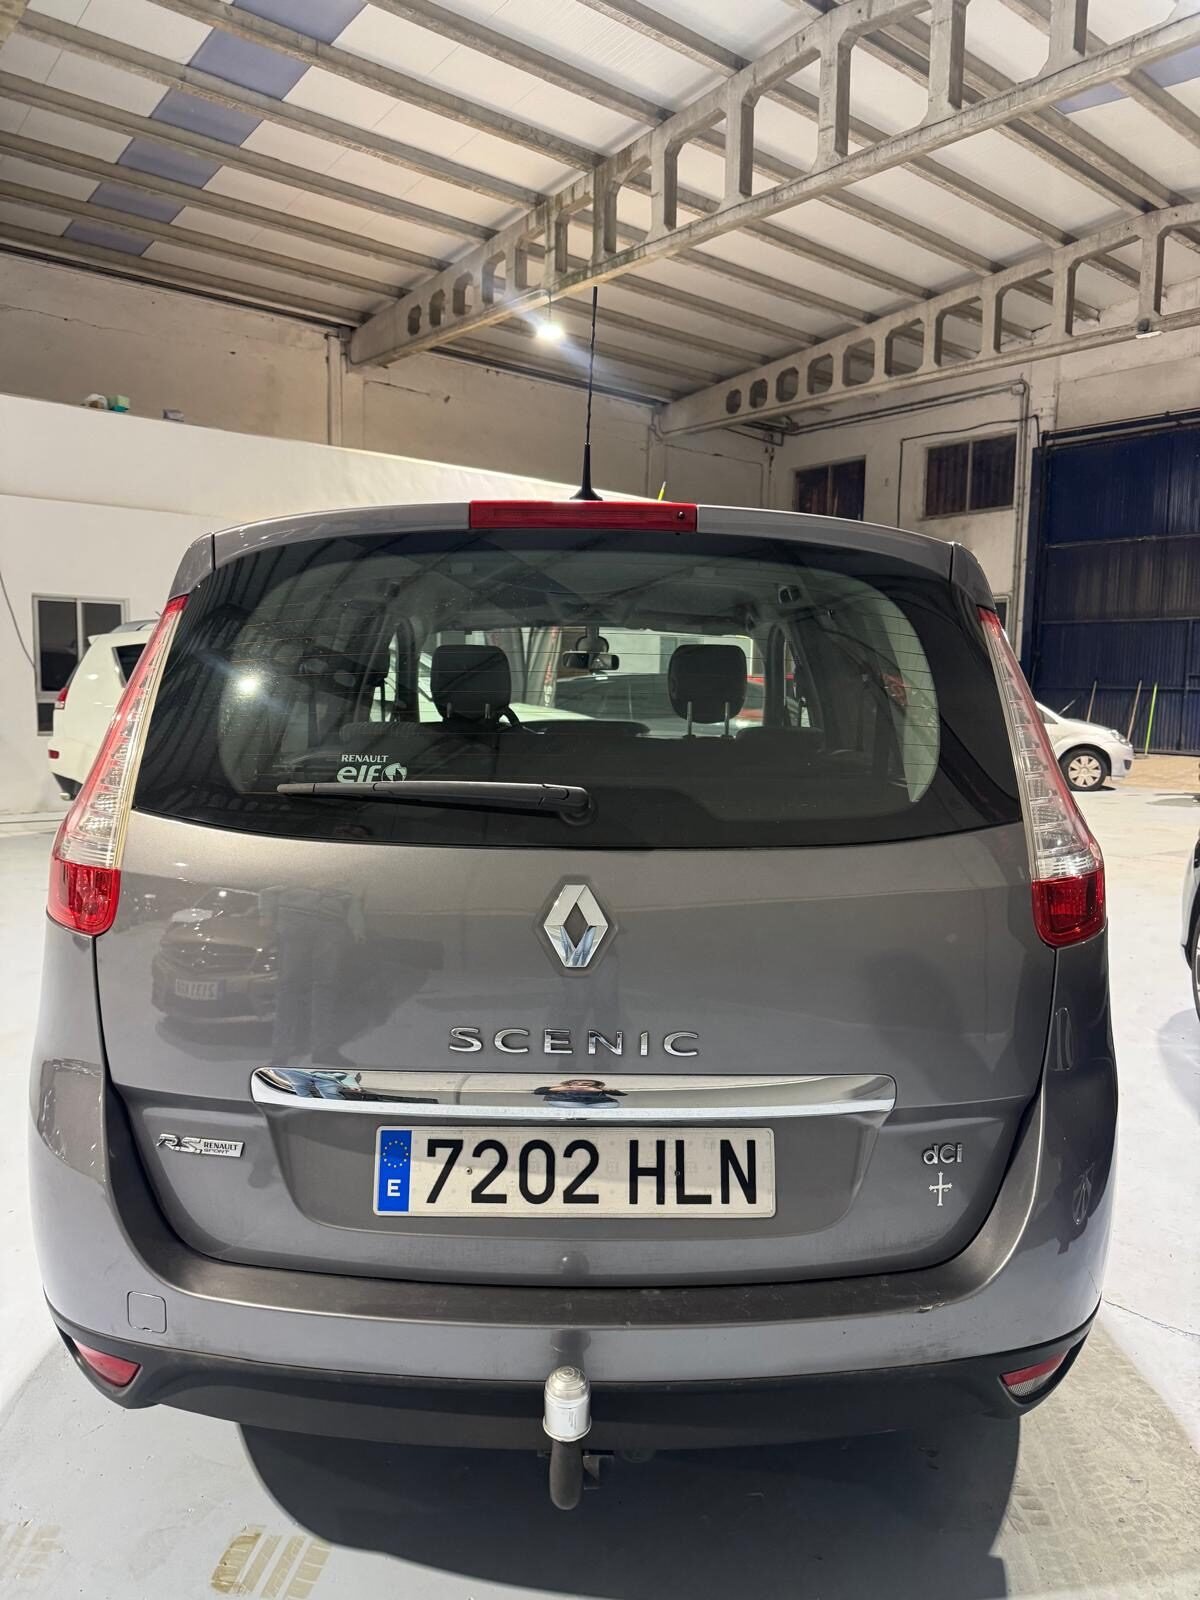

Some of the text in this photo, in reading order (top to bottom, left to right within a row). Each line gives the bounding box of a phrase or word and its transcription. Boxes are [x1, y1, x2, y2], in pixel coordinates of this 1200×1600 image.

[341, 754, 388, 763] RENAULT
[336, 764, 381, 783] elf
[449, 1027, 698, 1056] SCENIC
[203, 1141, 238, 1151] RENAULT
[923, 1144, 963, 1165] dCi
[426, 1138, 756, 1205] 7202 HLN
[387, 1178, 401, 1197] E
